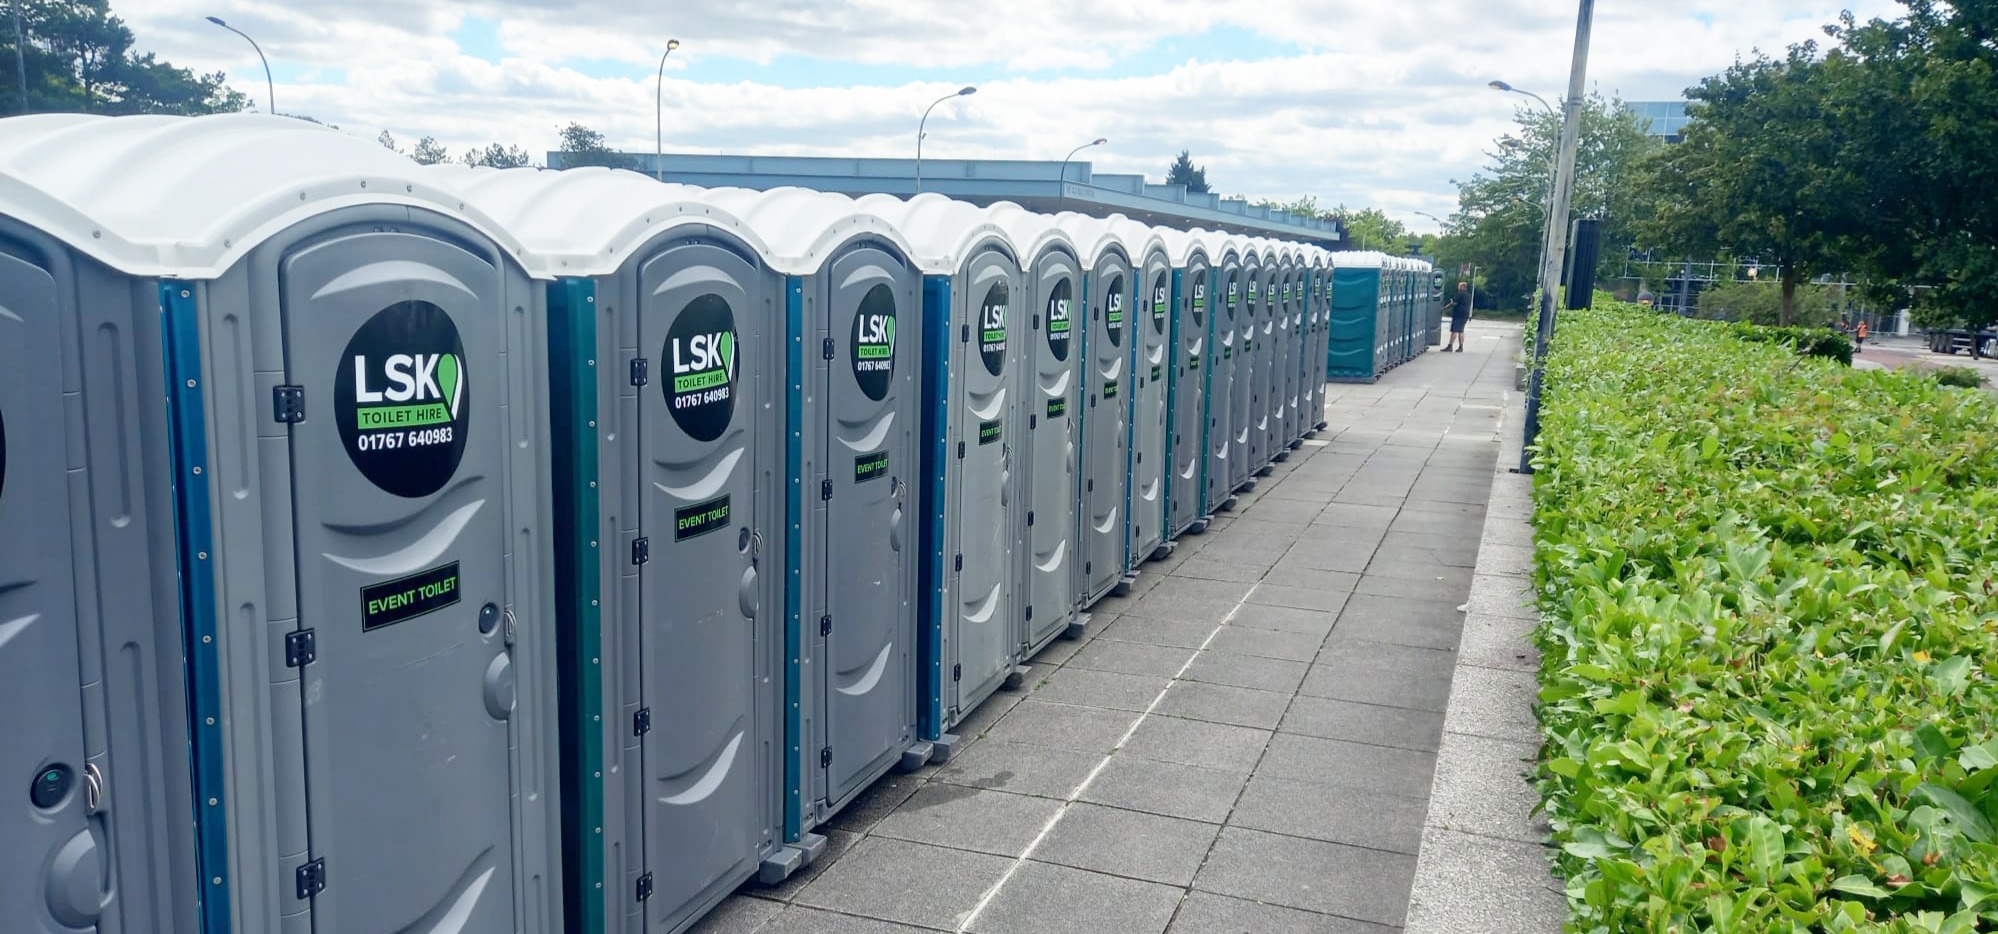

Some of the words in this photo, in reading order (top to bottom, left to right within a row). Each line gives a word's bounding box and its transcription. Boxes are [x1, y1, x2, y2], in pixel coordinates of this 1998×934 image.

[983, 305, 1006, 329] LSK
[1050, 299, 1069, 320] LSK
[858, 314, 889, 343] LSK
[672, 332, 723, 373] LSK
[355, 353, 441, 402] LSK
[857, 361, 874, 371] 01767
[678, 376, 706, 389] TOILET
[708, 373, 723, 385] HIRE
[675, 393, 702, 409] 01767
[703, 386, 730, 404] 640983
[362, 409, 412, 424] TOILET
[416, 407, 442, 422] HIRE
[358, 432, 404, 451] 01767
[408, 427, 453, 447] 640983
[857, 462, 875, 474] EVENT
[679, 513, 706, 530] EVENT
[707, 505, 729, 522] TOILET
[368, 590, 416, 615] EVENT
[418, 576, 456, 600] TOILET
